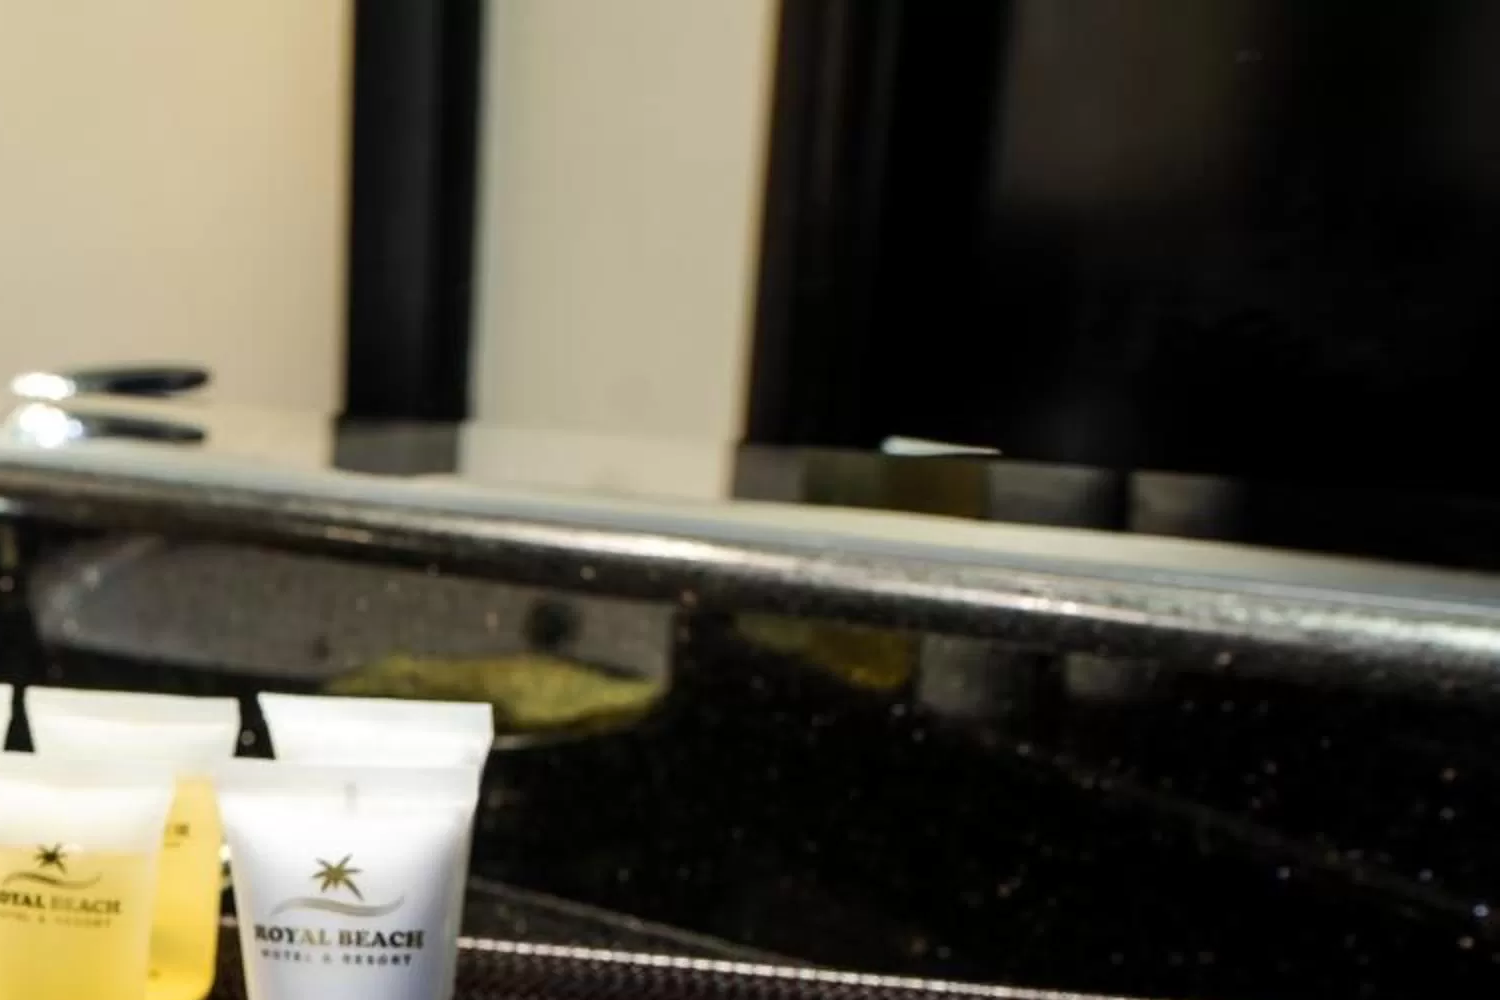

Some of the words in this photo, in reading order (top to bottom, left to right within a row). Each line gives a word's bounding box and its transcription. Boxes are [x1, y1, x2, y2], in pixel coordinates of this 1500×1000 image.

[254, 923, 331, 947] ROYAL
[338, 929, 425, 950] BEACH
[342, 951, 412, 967] RESORT
